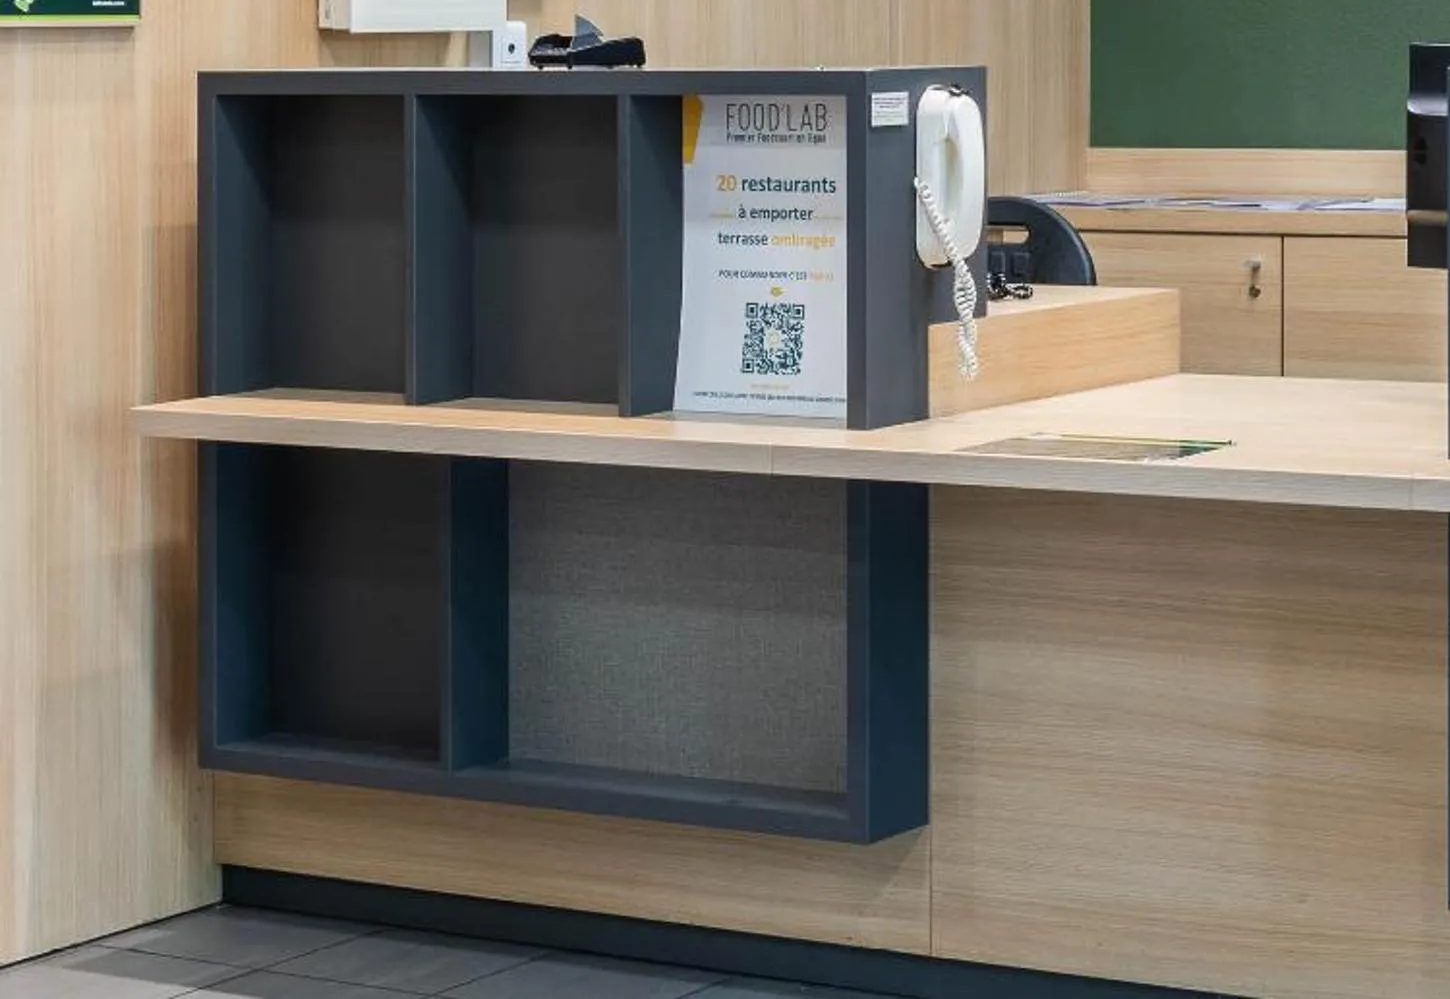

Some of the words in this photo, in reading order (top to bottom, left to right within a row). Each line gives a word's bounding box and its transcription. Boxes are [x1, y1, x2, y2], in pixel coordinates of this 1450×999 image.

[726, 102, 828, 132] FOOD'LAB
[716, 174, 738, 193] 20
[741, 176, 837, 194] restaurants
[738, 204, 747, 219] à
[749, 207, 814, 222] emporter
[718, 231, 769, 246] terrasse
